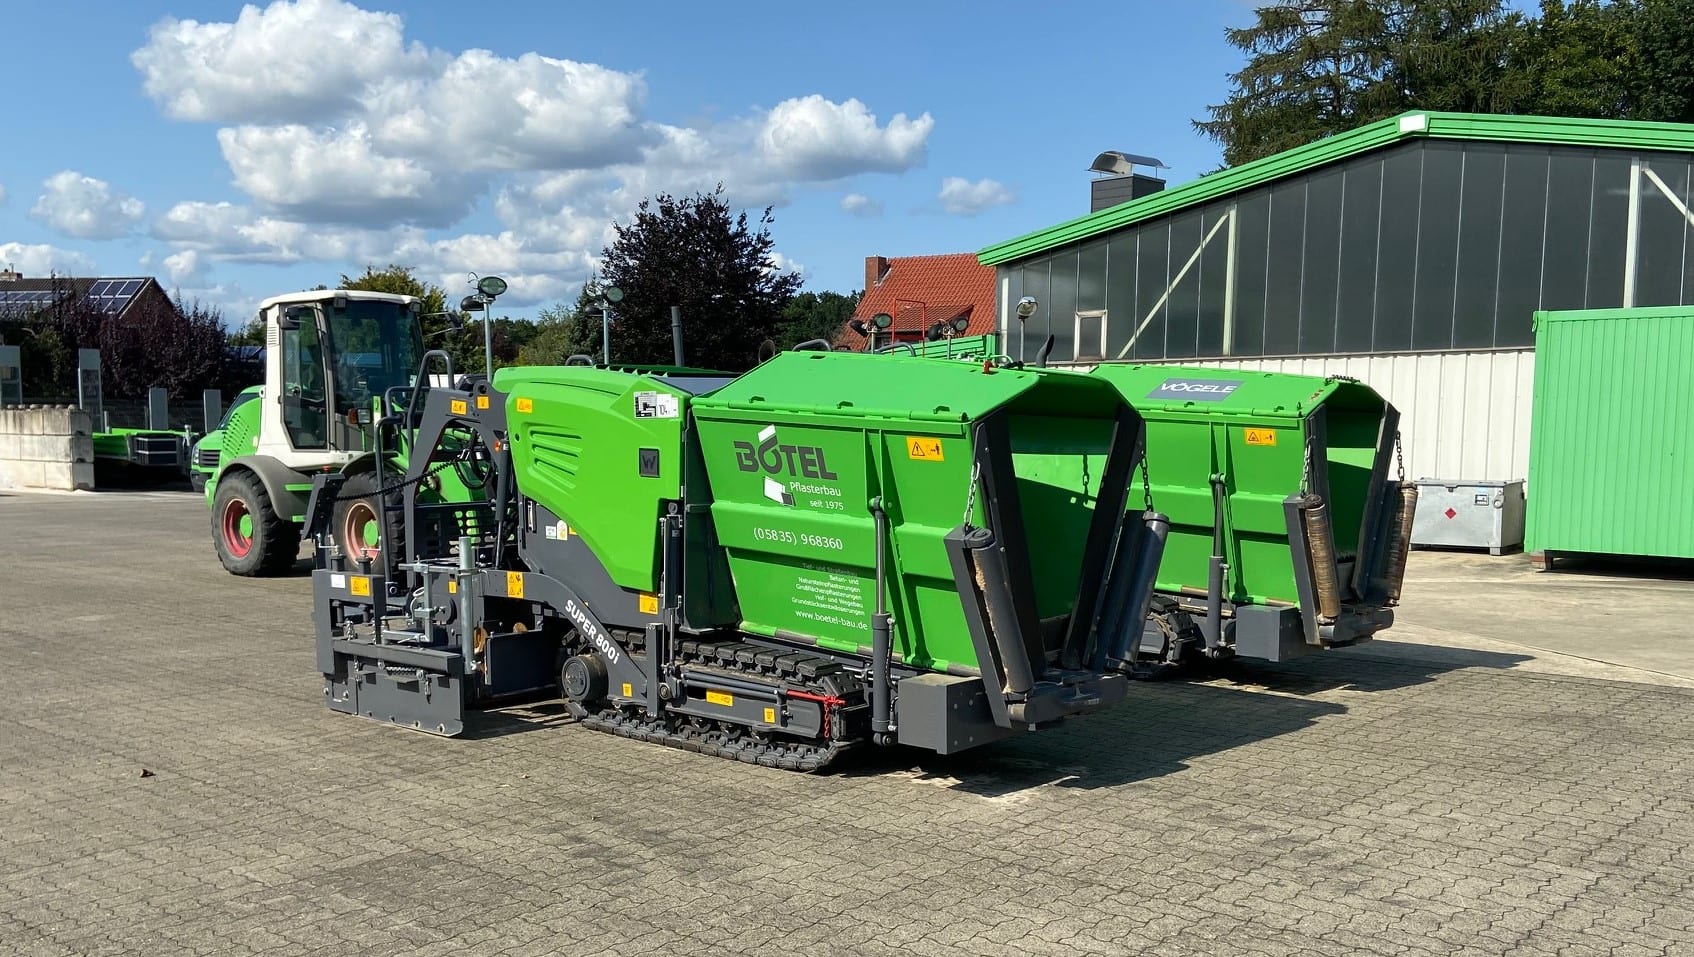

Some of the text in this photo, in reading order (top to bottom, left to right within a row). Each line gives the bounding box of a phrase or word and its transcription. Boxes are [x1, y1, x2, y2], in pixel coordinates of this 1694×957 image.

[1161, 382, 1237, 393] VÖGELE
[642, 454, 657, 470] W
[789, 481, 842, 497] Pflasterbau
[809, 499, 844, 511] seit 1975
[753, 527, 844, 550] (05835) 968360
[795, 610, 868, 631] www.boetel-bau.de
[565, 599, 620, 665] SUPER 800i
